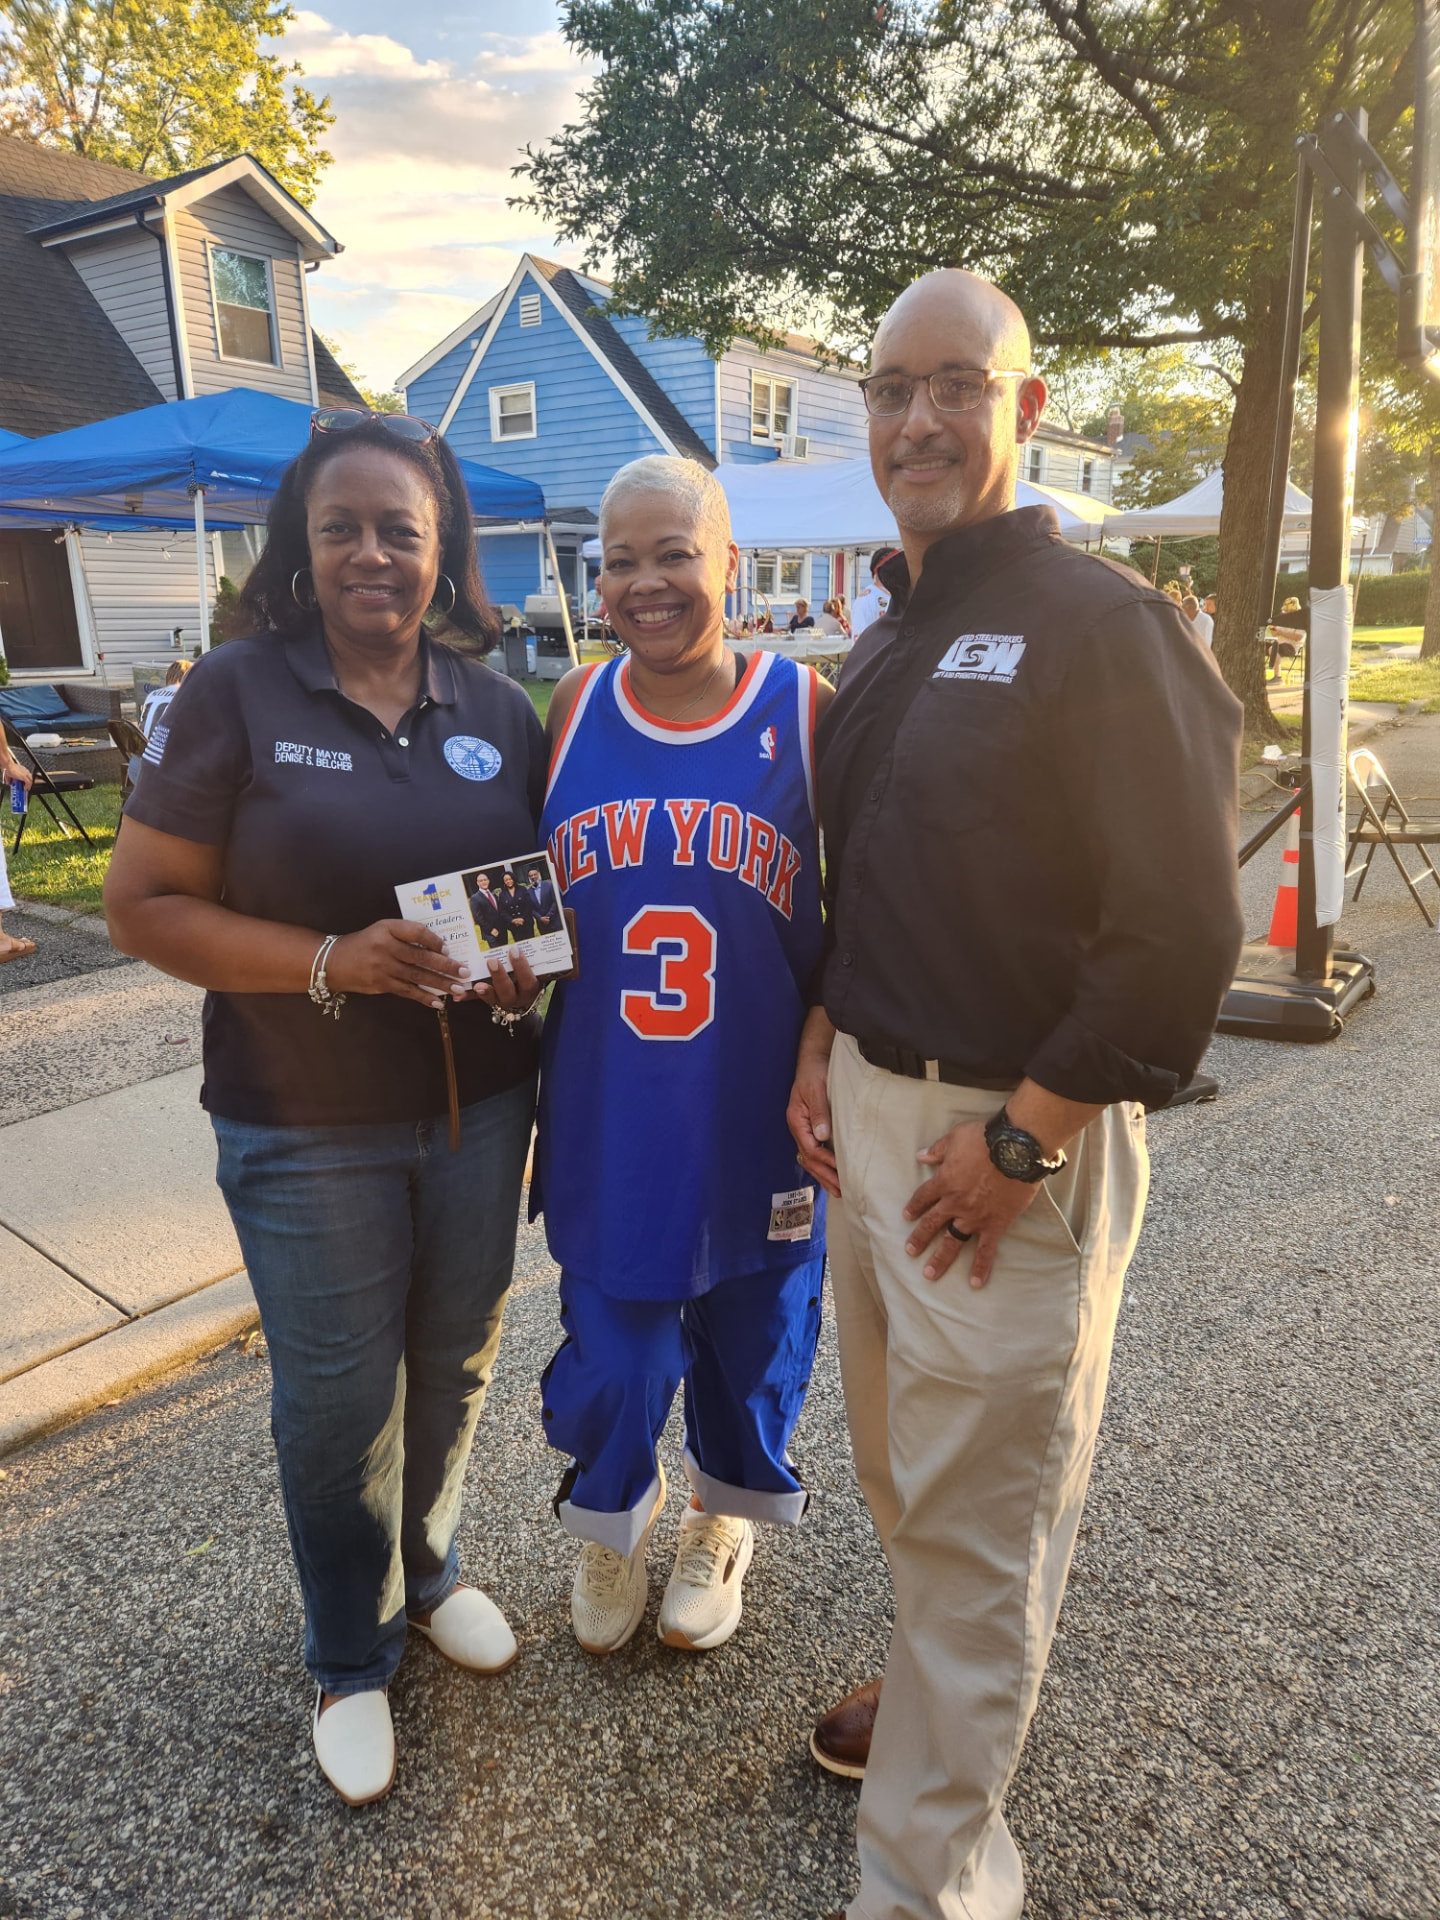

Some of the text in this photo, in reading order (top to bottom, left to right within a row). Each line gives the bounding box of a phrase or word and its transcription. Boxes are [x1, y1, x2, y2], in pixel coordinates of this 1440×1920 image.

[937, 641, 1027, 675] USW
[275, 741, 352, 762] DEPUTY MAYOR
[275, 752, 352, 771] DENISE S. BELCHER
[547, 798, 802, 922] NEW YORK
[411, 889, 451, 904] TEANECK
[620, 904, 718, 1041] 3
